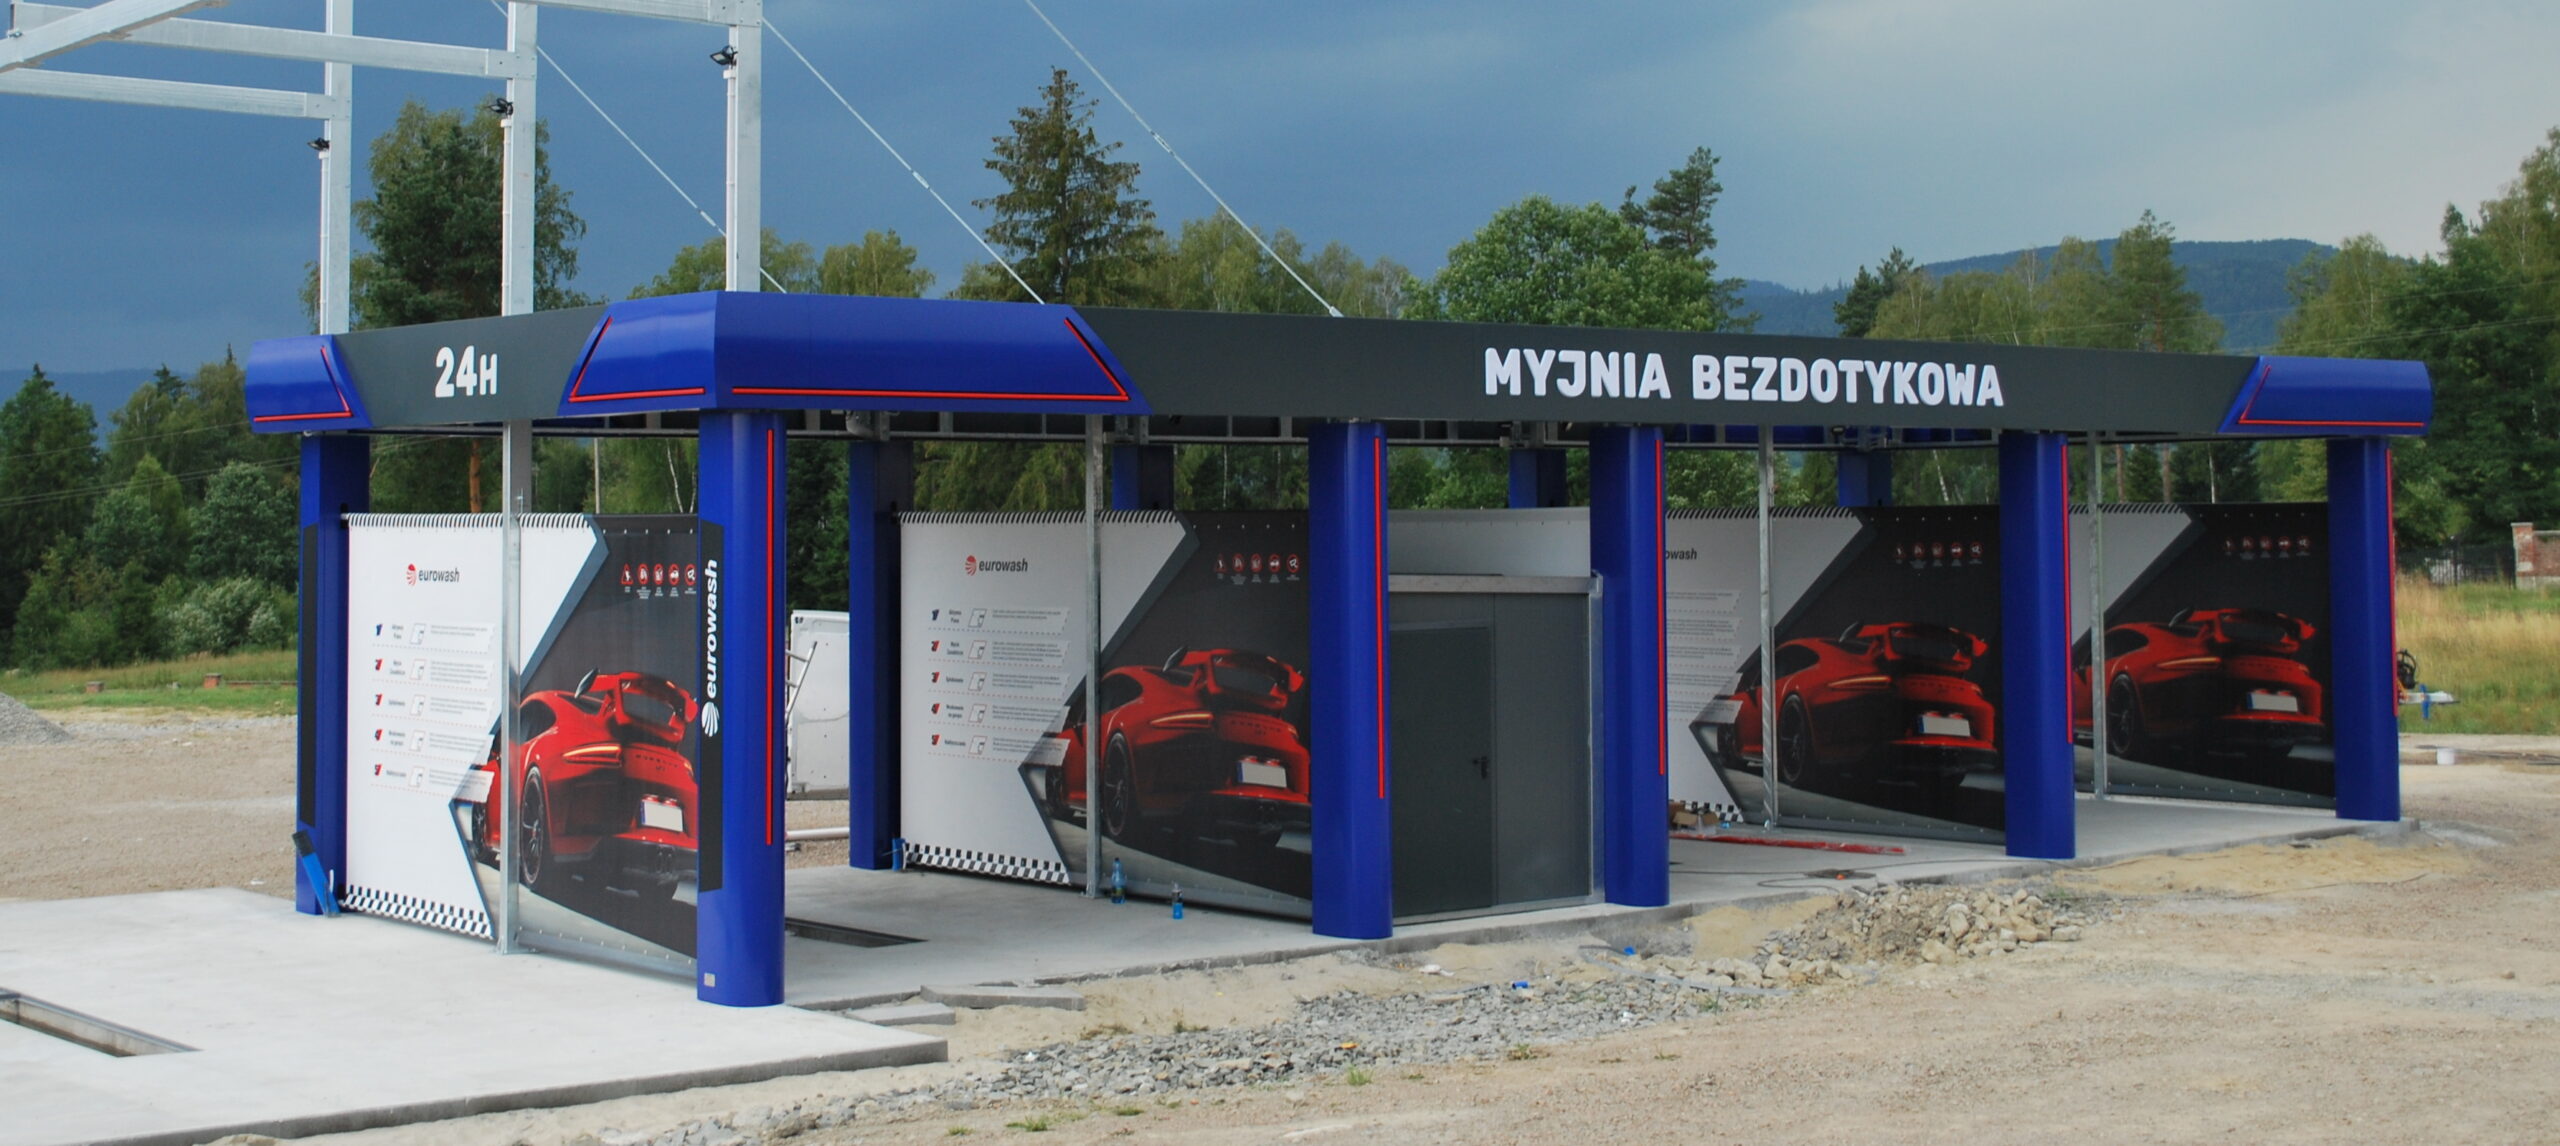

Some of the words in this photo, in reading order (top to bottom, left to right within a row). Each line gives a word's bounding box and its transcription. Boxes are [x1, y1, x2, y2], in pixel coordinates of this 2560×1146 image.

[435, 345, 498, 398] 24H
[1485, 347, 1672, 399] MYJNIA
[1692, 354, 2004, 407] BEZDOTYKOWA
[418, 567, 460, 583] eurowash
[979, 557, 1028, 572] eurowash
[704, 559, 718, 699] eurowash
